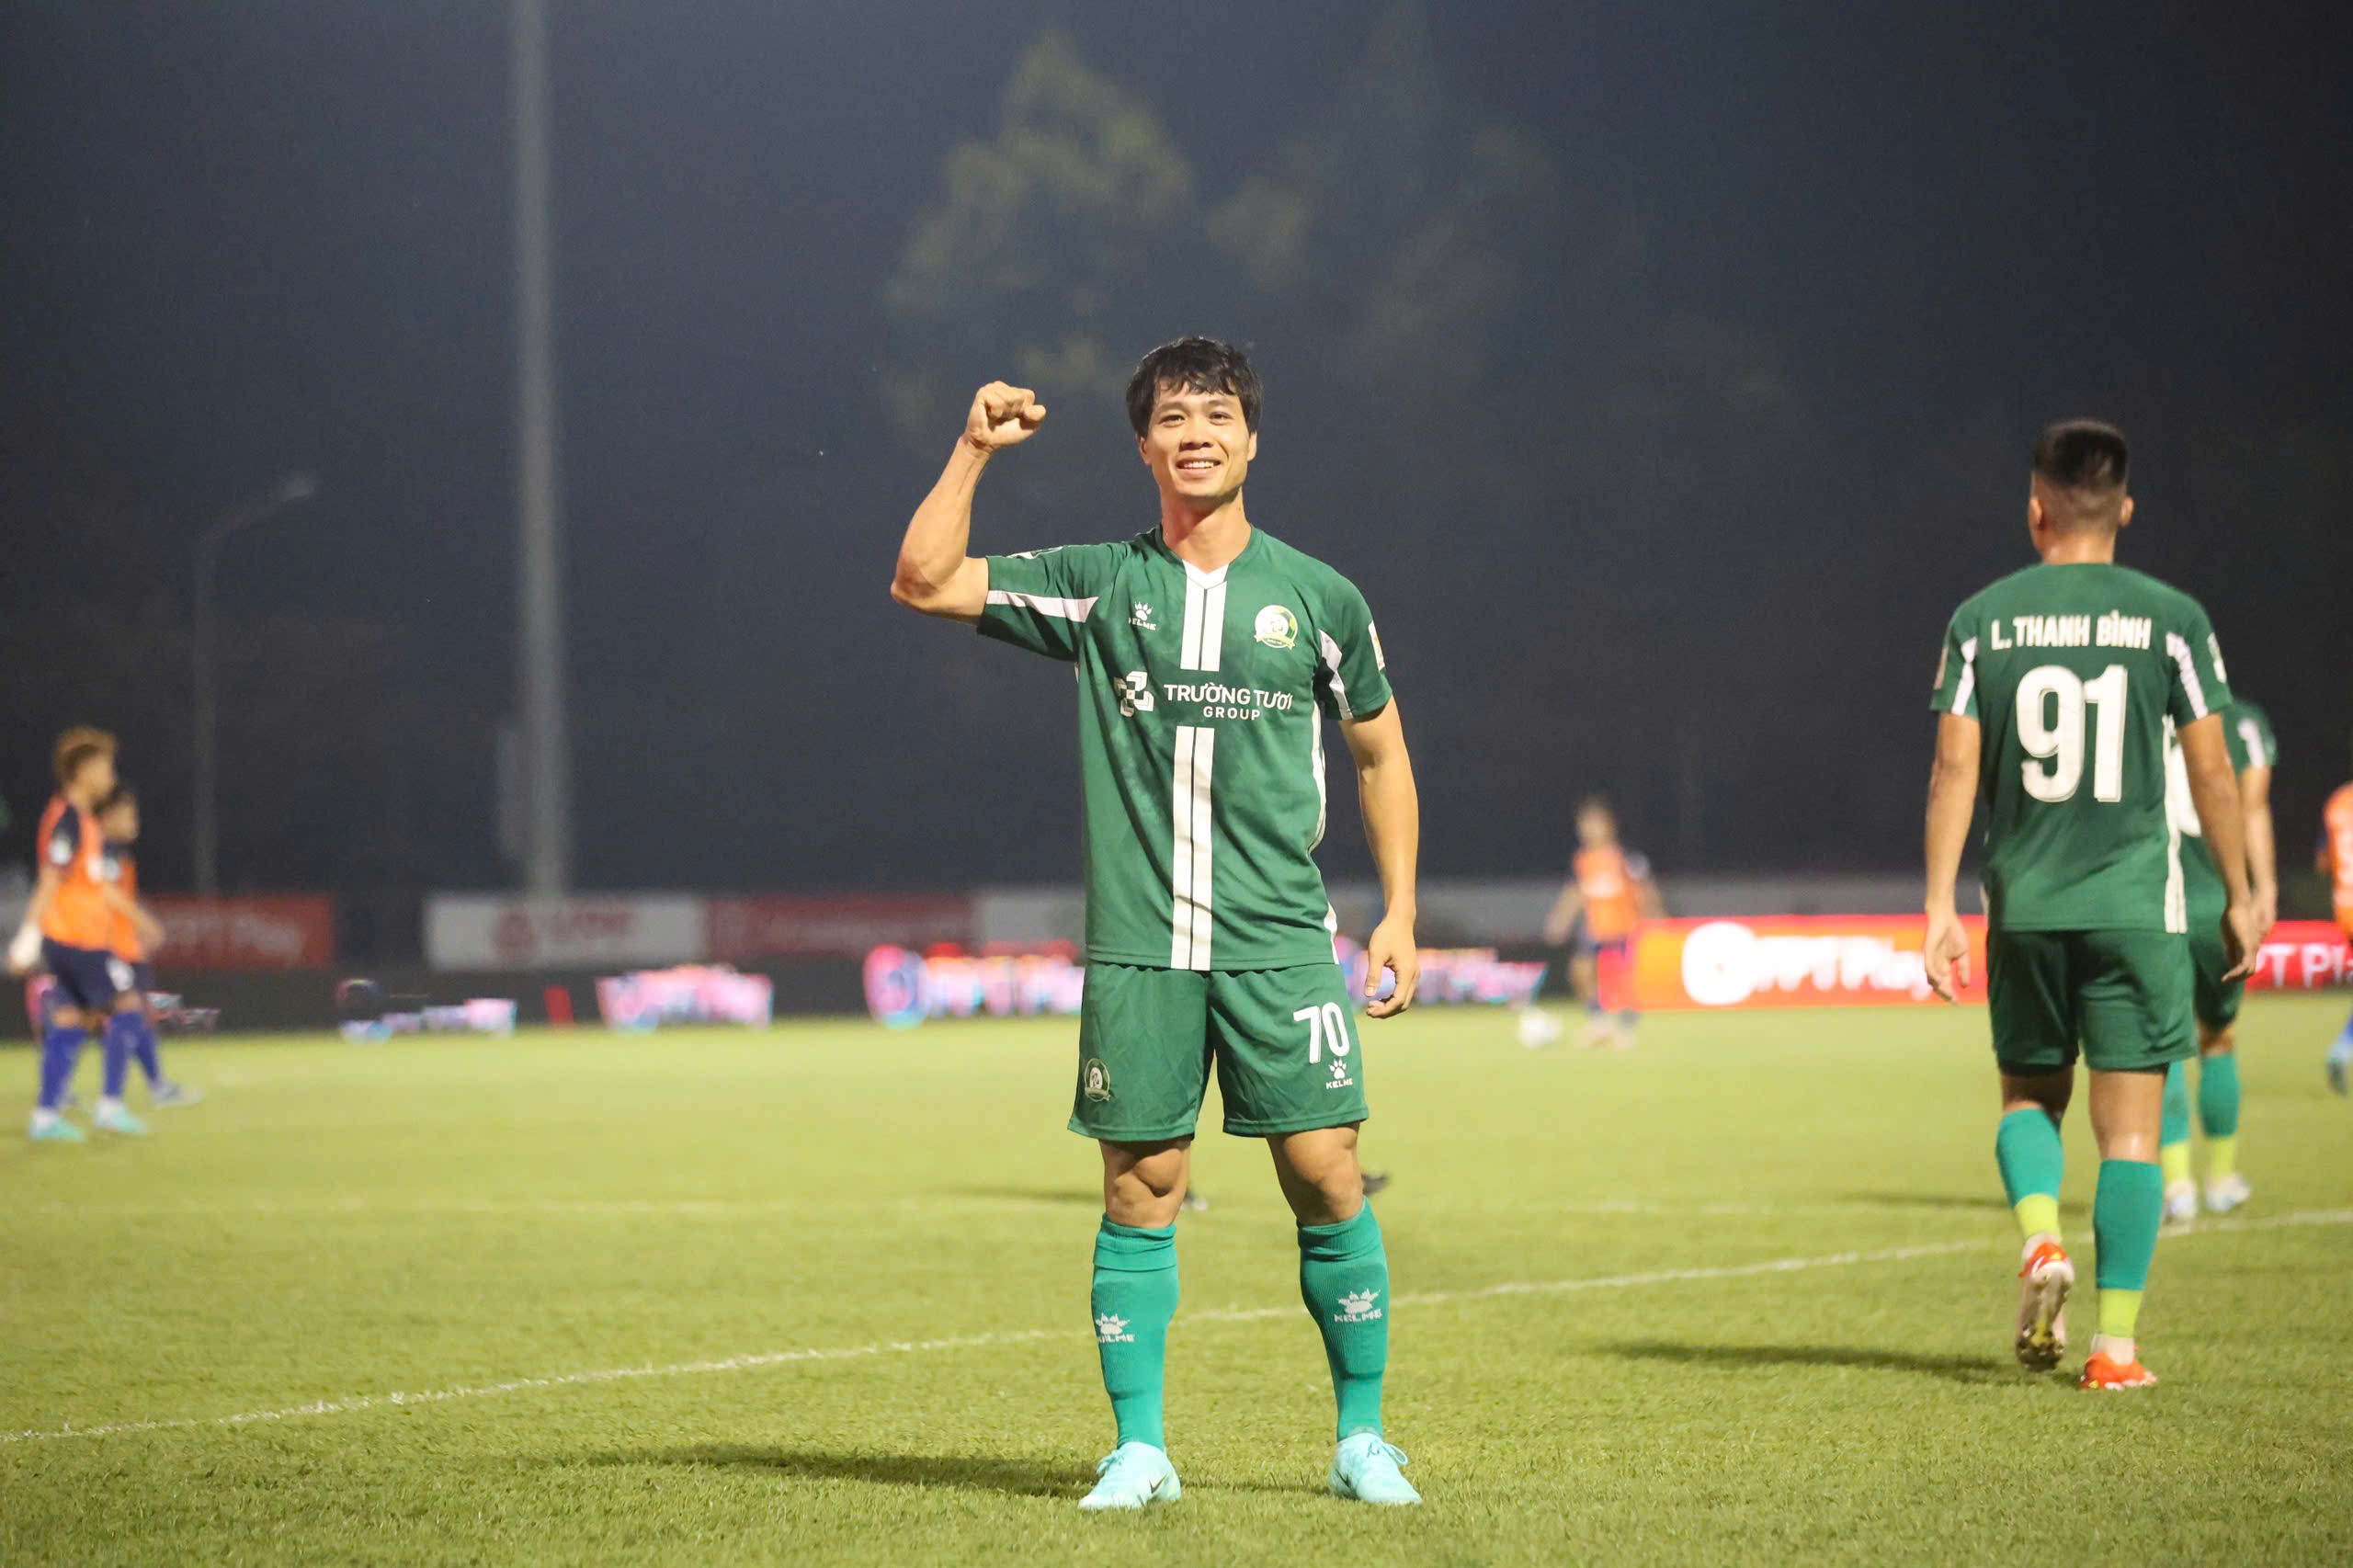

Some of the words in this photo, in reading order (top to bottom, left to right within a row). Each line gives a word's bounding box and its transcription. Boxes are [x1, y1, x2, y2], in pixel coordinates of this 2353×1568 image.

[1164, 682, 1251, 705] TRƯỜNG
[1253, 689, 1293, 710] TƯƠI
[1203, 705, 1261, 721] GROUP
[2016, 664, 2128, 803] 91
[1292, 1001, 1350, 1064] 70
[1325, 1077, 1353, 1090] KELME
[1334, 1308, 1383, 1323] KELME
